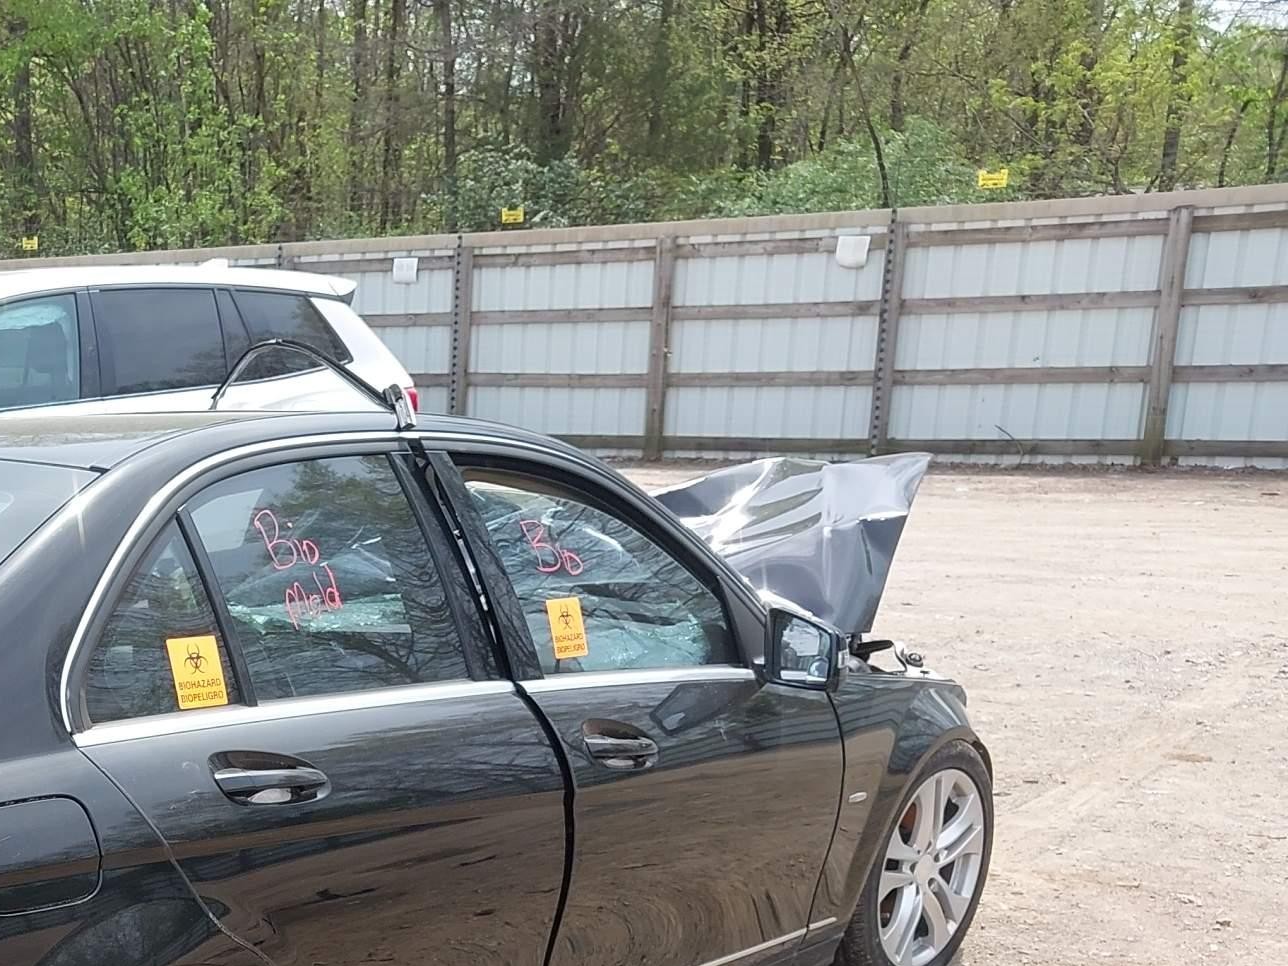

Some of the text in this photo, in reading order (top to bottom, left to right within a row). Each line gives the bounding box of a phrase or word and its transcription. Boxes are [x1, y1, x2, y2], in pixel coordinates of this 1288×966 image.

[254, 509, 320, 570] Bio
[178, 678, 222, 691] BIOHAZARD
[180, 690, 224, 704] BIOPELIGRO
